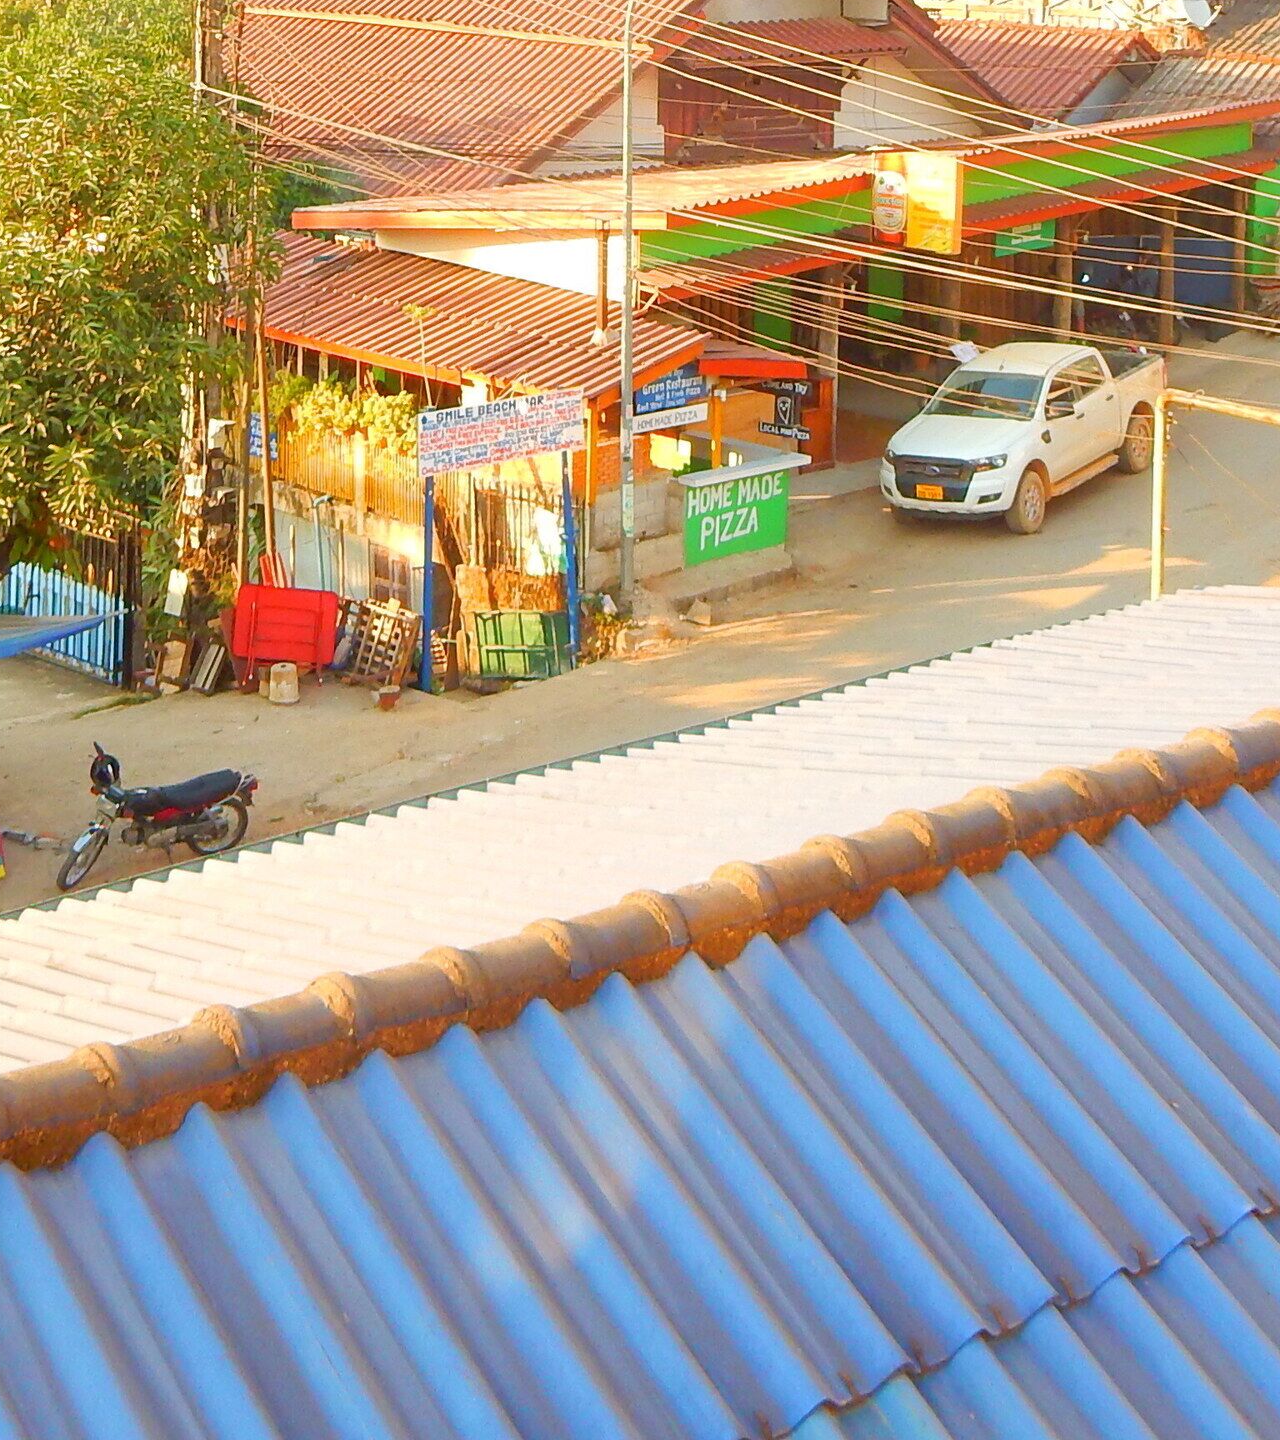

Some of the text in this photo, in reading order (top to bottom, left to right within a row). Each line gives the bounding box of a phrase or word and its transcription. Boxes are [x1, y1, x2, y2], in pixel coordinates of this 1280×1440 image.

[642, 375, 702, 395] Green Restaurant
[436, 407, 474, 423] SMILE
[478, 399, 516, 416] BEACH
[525, 394, 544, 406] AR
[687, 471, 784, 519] HOME MADE
[700, 506, 759, 551] PIZZA
